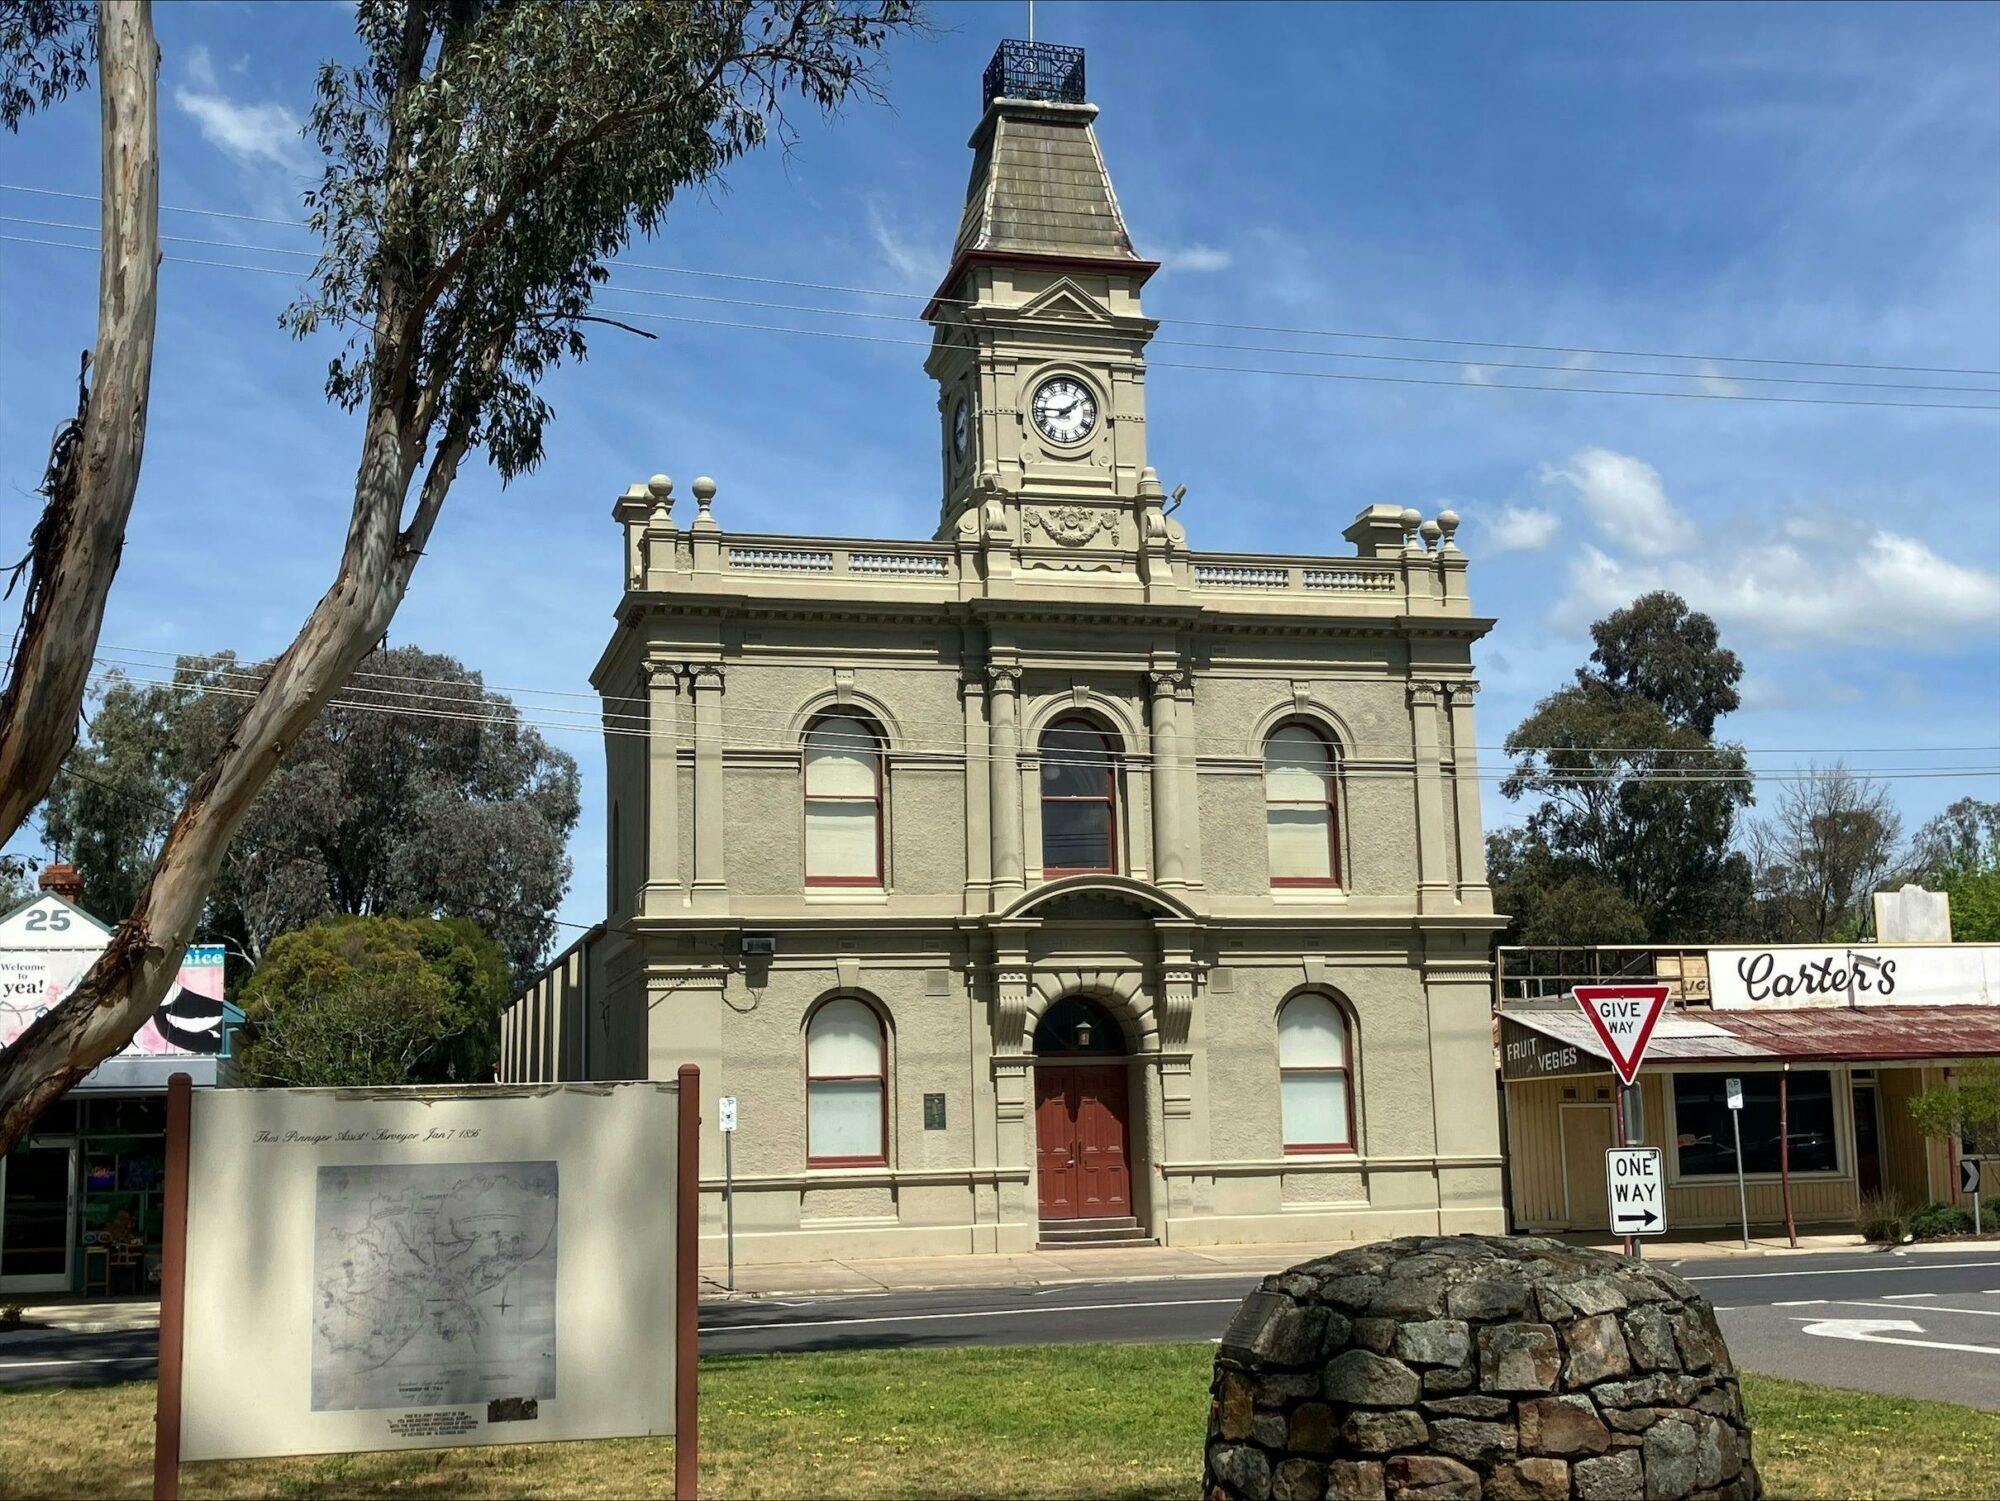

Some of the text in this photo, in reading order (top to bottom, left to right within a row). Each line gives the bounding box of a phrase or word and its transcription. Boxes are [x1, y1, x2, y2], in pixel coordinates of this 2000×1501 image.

[25, 909, 71, 932] 25
[1, 962, 46, 971] Welcome
[1737, 953, 1896, 1001] Carter's
[3, 979, 44, 998] yea!
[1600, 1002, 1641, 1018] GIVE
[1608, 1021, 1635, 1034] WAY
[1506, 1037, 1537, 1062] FRUIT
[1537, 1046, 1577, 1072] VEGIES
[372, 1128, 420, 1143] Surveyor
[422, 1127, 446, 1142] Jan
[446, 1129, 456, 1139] 7
[1616, 1158, 1653, 1176] ONE
[1615, 1184, 1656, 1202] WAY
